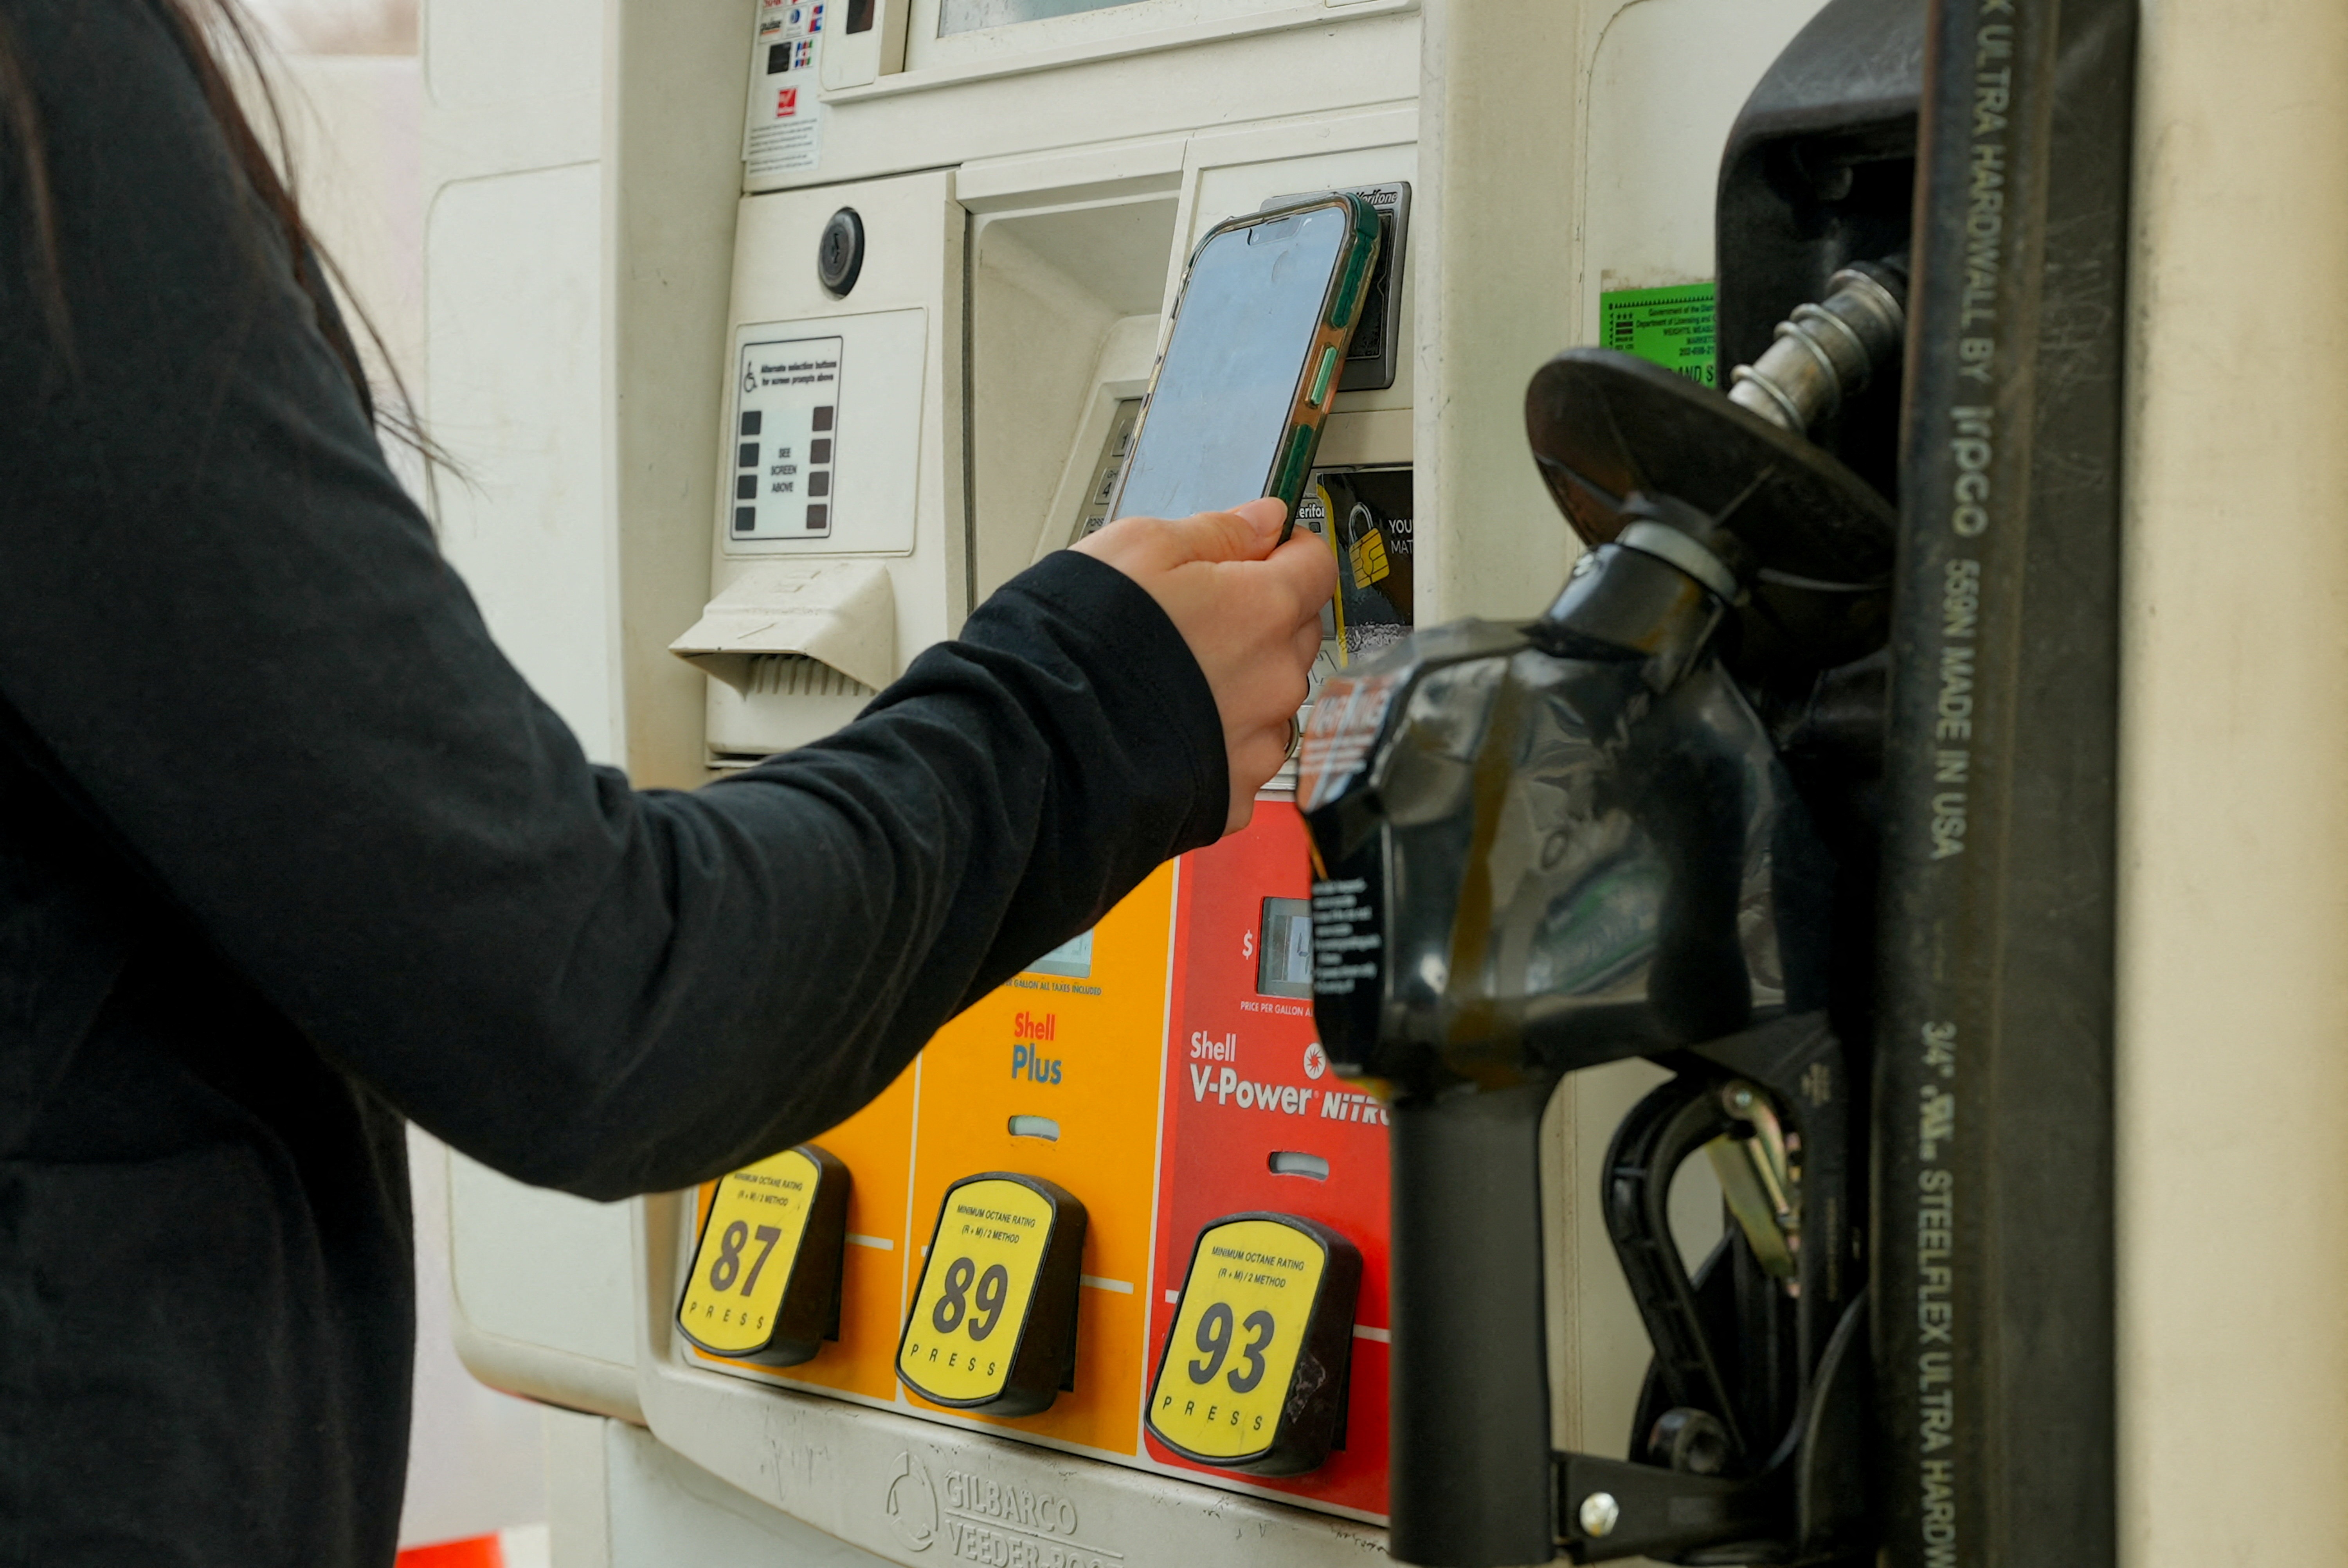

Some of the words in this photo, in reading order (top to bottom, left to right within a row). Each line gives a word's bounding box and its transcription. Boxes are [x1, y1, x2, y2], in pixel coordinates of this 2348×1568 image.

[1972, 24, 2015, 136] ULTRA
[1961, 144, 2006, 330] HARDWALL
[1959, 337, 1996, 384] BY
[779, 447, 790, 458] SEE
[771, 464, 797, 476] SCREEN
[771, 482, 793, 493] ABOVE
[1102, 482, 1112, 498] 4
[1388, 519, 1412, 534] YOU
[1935, 646, 1976, 741] MADE
[1934, 749, 1970, 782] IN
[1929, 792, 1968, 860] USA
[1242, 930, 1253, 960] $
[1014, 979, 1038, 989] GALLON
[1040, 982, 1050, 991] ALL
[1052, 983, 1070, 993] TAXES
[1072, 985, 1102, 996] INCLUDED
[1241, 1001, 1259, 1012] PRICE
[1260, 1003, 1273, 1013] PER
[1275, 1004, 1304, 1016] GALLON
[1014, 1011, 1055, 1041] Shell
[1190, 1030, 1236, 1062] Shell
[1012, 1043, 1062, 1084] Plus
[1190, 1063, 1313, 1116] V-Power
[735, 1173, 758, 1182] MINIMUM
[758, 1176, 781, 1187] OCTANE
[782, 1180, 803, 1191] RATING
[765, 1195, 788, 1206] METHOD
[957, 1205, 985, 1218] MINIMUM
[985, 1210, 1012, 1223] OCTANE
[1012, 1215, 1036, 1228] RATING
[992, 1230, 1020, 1243] METHOD
[710, 1220, 782, 1297] 87
[1212, 1246, 1244, 1260] MINIMUM
[1245, 1253, 1275, 1266] OCTANE
[1277, 1257, 1305, 1271] RATING
[1918, 1169, 1955, 1344] STEELFLEX
[1253, 1274, 1286, 1288] METHOD
[690, 1302, 764, 1329] PRESS
[933, 1257, 1008, 1342] 89
[910, 1344, 996, 1376] PRESS
[1188, 1302, 1275, 1393] 93
[1162, 1396, 1263, 1431] PRESS
[1918, 1351, 1954, 1453] ULTRA
[944, 1469, 1077, 1536] GILBARCO
